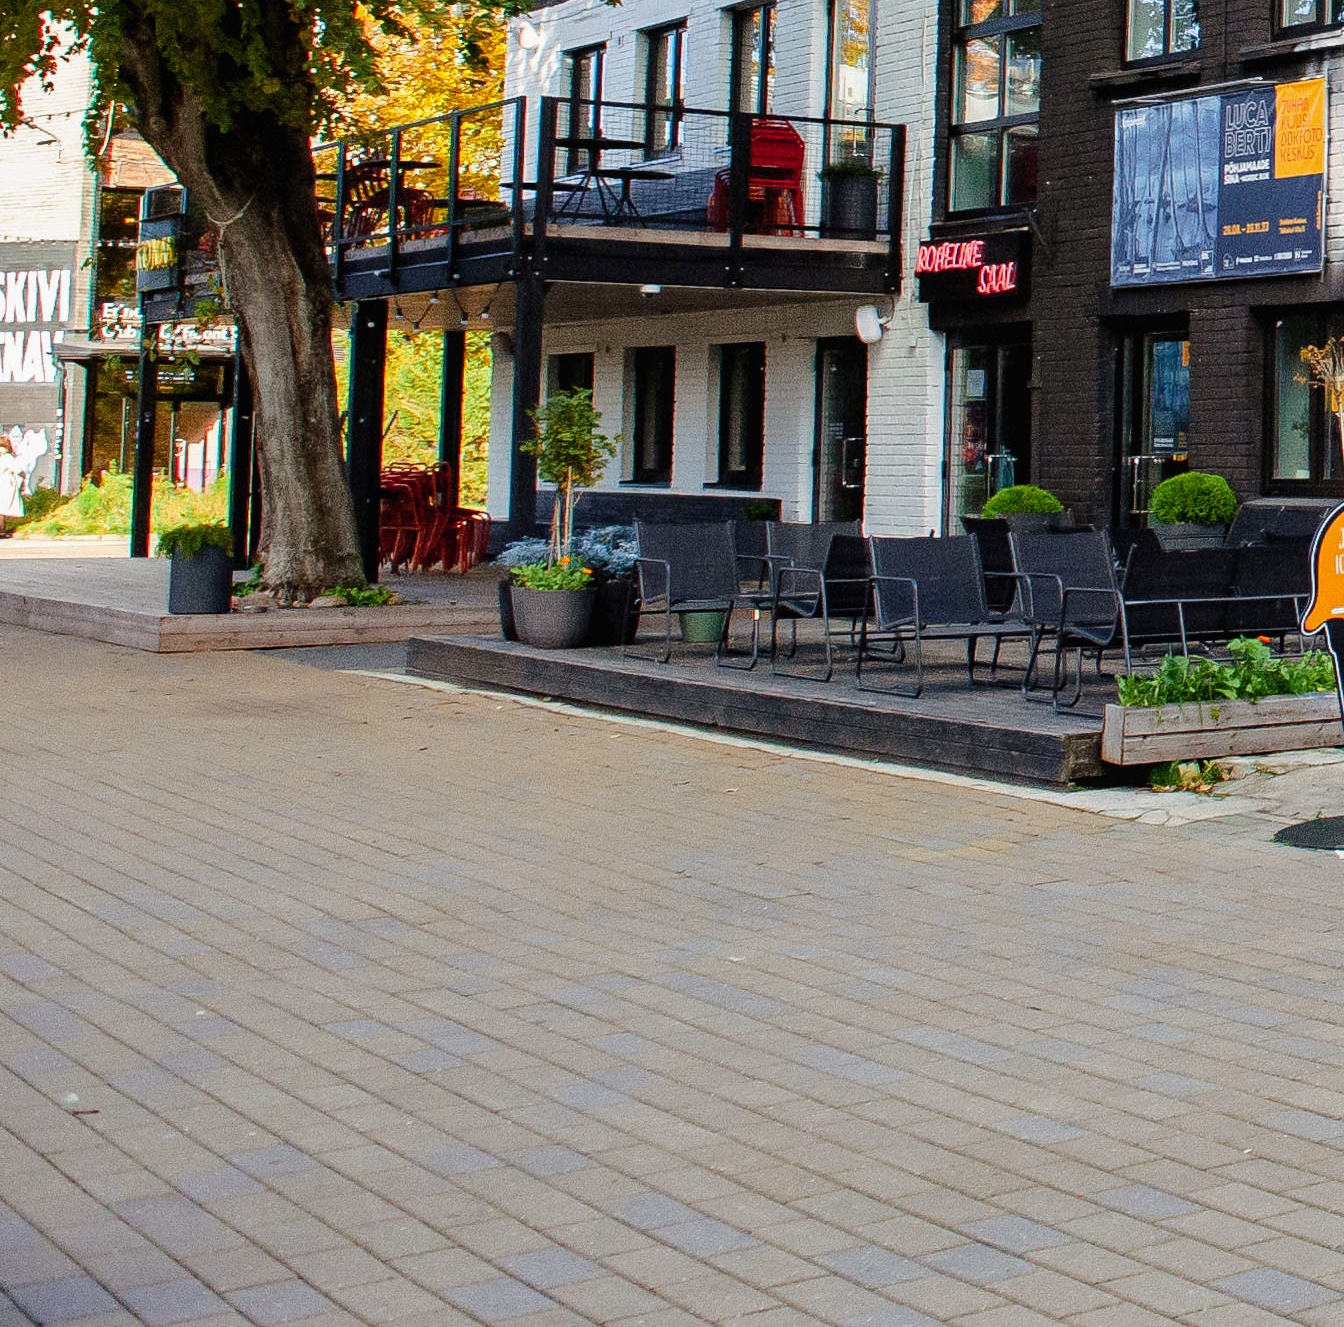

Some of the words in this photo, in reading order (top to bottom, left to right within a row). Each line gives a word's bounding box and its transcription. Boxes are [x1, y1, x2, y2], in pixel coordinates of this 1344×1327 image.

[1225, 100, 1269, 131] LUCA
[1224, 126, 1272, 158] BERTI
[1280, 127, 1322, 147] DOKFOTO
[1280, 144, 1315, 163] KESKUS
[977, 262, 1016, 293] SAAL
[0, 330, 65, 383] NAV
